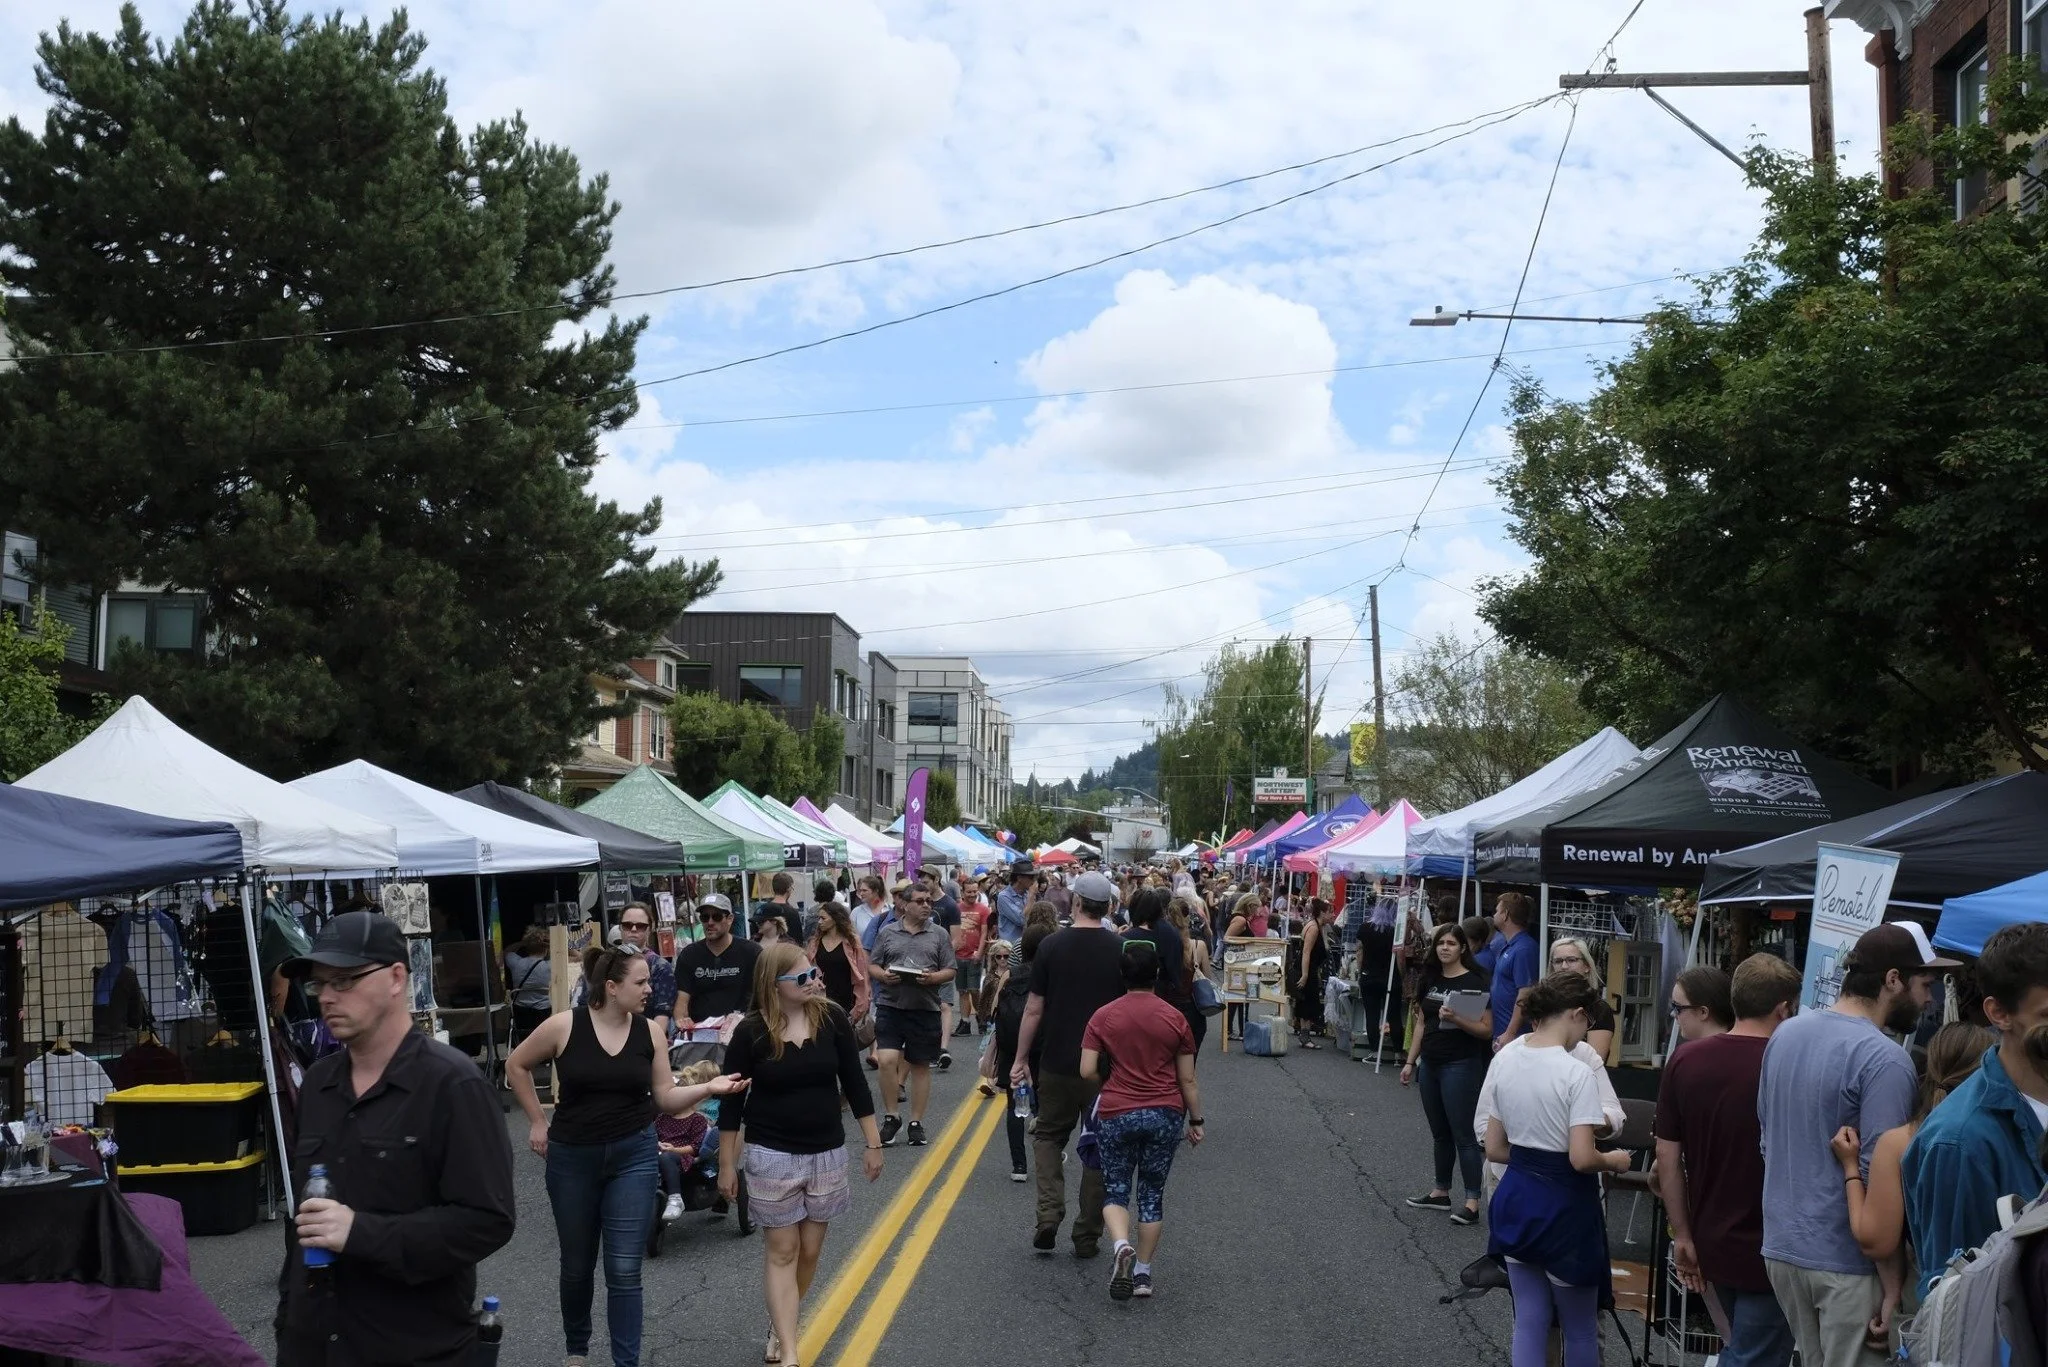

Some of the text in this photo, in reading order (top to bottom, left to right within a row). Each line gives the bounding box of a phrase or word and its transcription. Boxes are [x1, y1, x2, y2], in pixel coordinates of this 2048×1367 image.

[1686, 745, 1802, 764] Renewal
[1757, 799, 1827, 809] REPLACEMENT
[1729, 806, 1779, 817] Andersen
[1780, 809, 1832, 820] Company
[1563, 844, 1644, 864] Renewal
[1652, 845, 1674, 867] by
